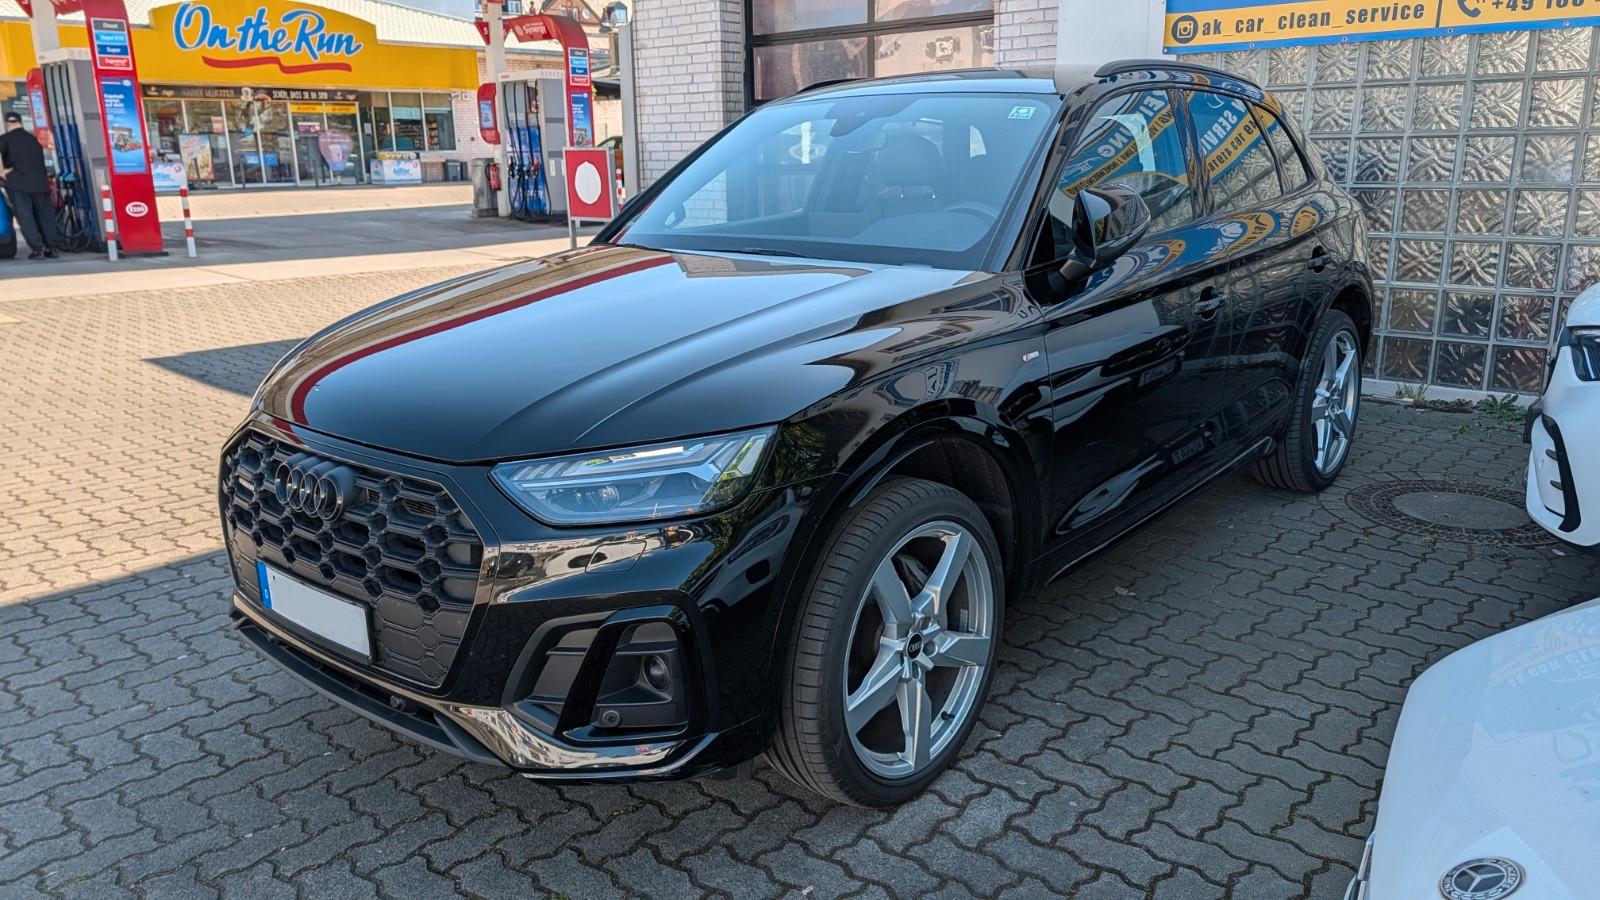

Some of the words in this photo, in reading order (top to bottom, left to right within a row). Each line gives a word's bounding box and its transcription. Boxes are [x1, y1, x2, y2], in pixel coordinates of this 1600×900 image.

[174, 2, 236, 50] On
[237, 7, 293, 53] the
[282, 9, 362, 61] Run
[1202, 3, 1425, 37] ak_car_clean_service
